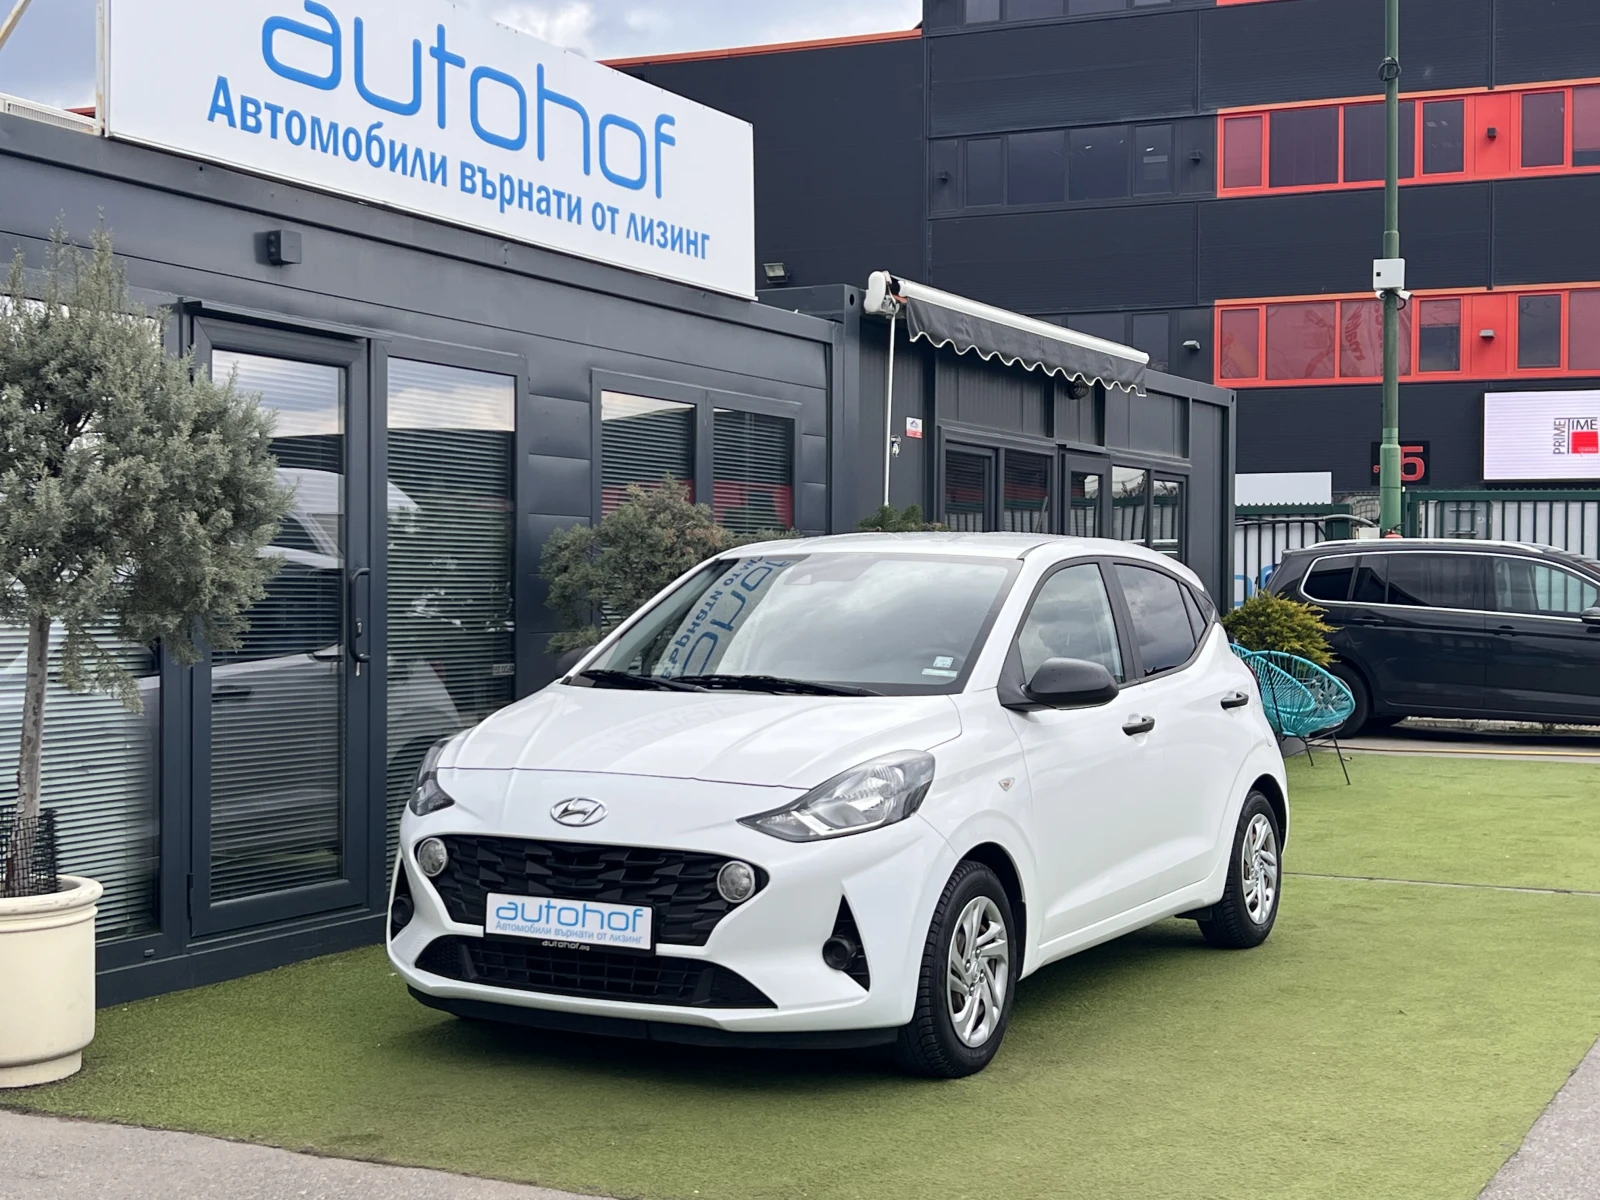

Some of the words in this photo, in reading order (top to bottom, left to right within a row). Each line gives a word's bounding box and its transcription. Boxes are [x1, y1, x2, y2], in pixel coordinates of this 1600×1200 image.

[261, 0, 676, 199] autohof
[207, 75, 448, 188] Автомобили
[459, 160, 584, 226] върнати
[591, 202, 621, 235] от
[625, 212, 711, 260] лизинг
[1552, 420, 1566, 455] PRIME
[495, 900, 644, 933] autohof
[495, 920, 552, 935] Автомобили
[554, 928, 595, 942] върнати
[597, 932, 607, 941] от
[609, 934, 643, 944] лизинг
